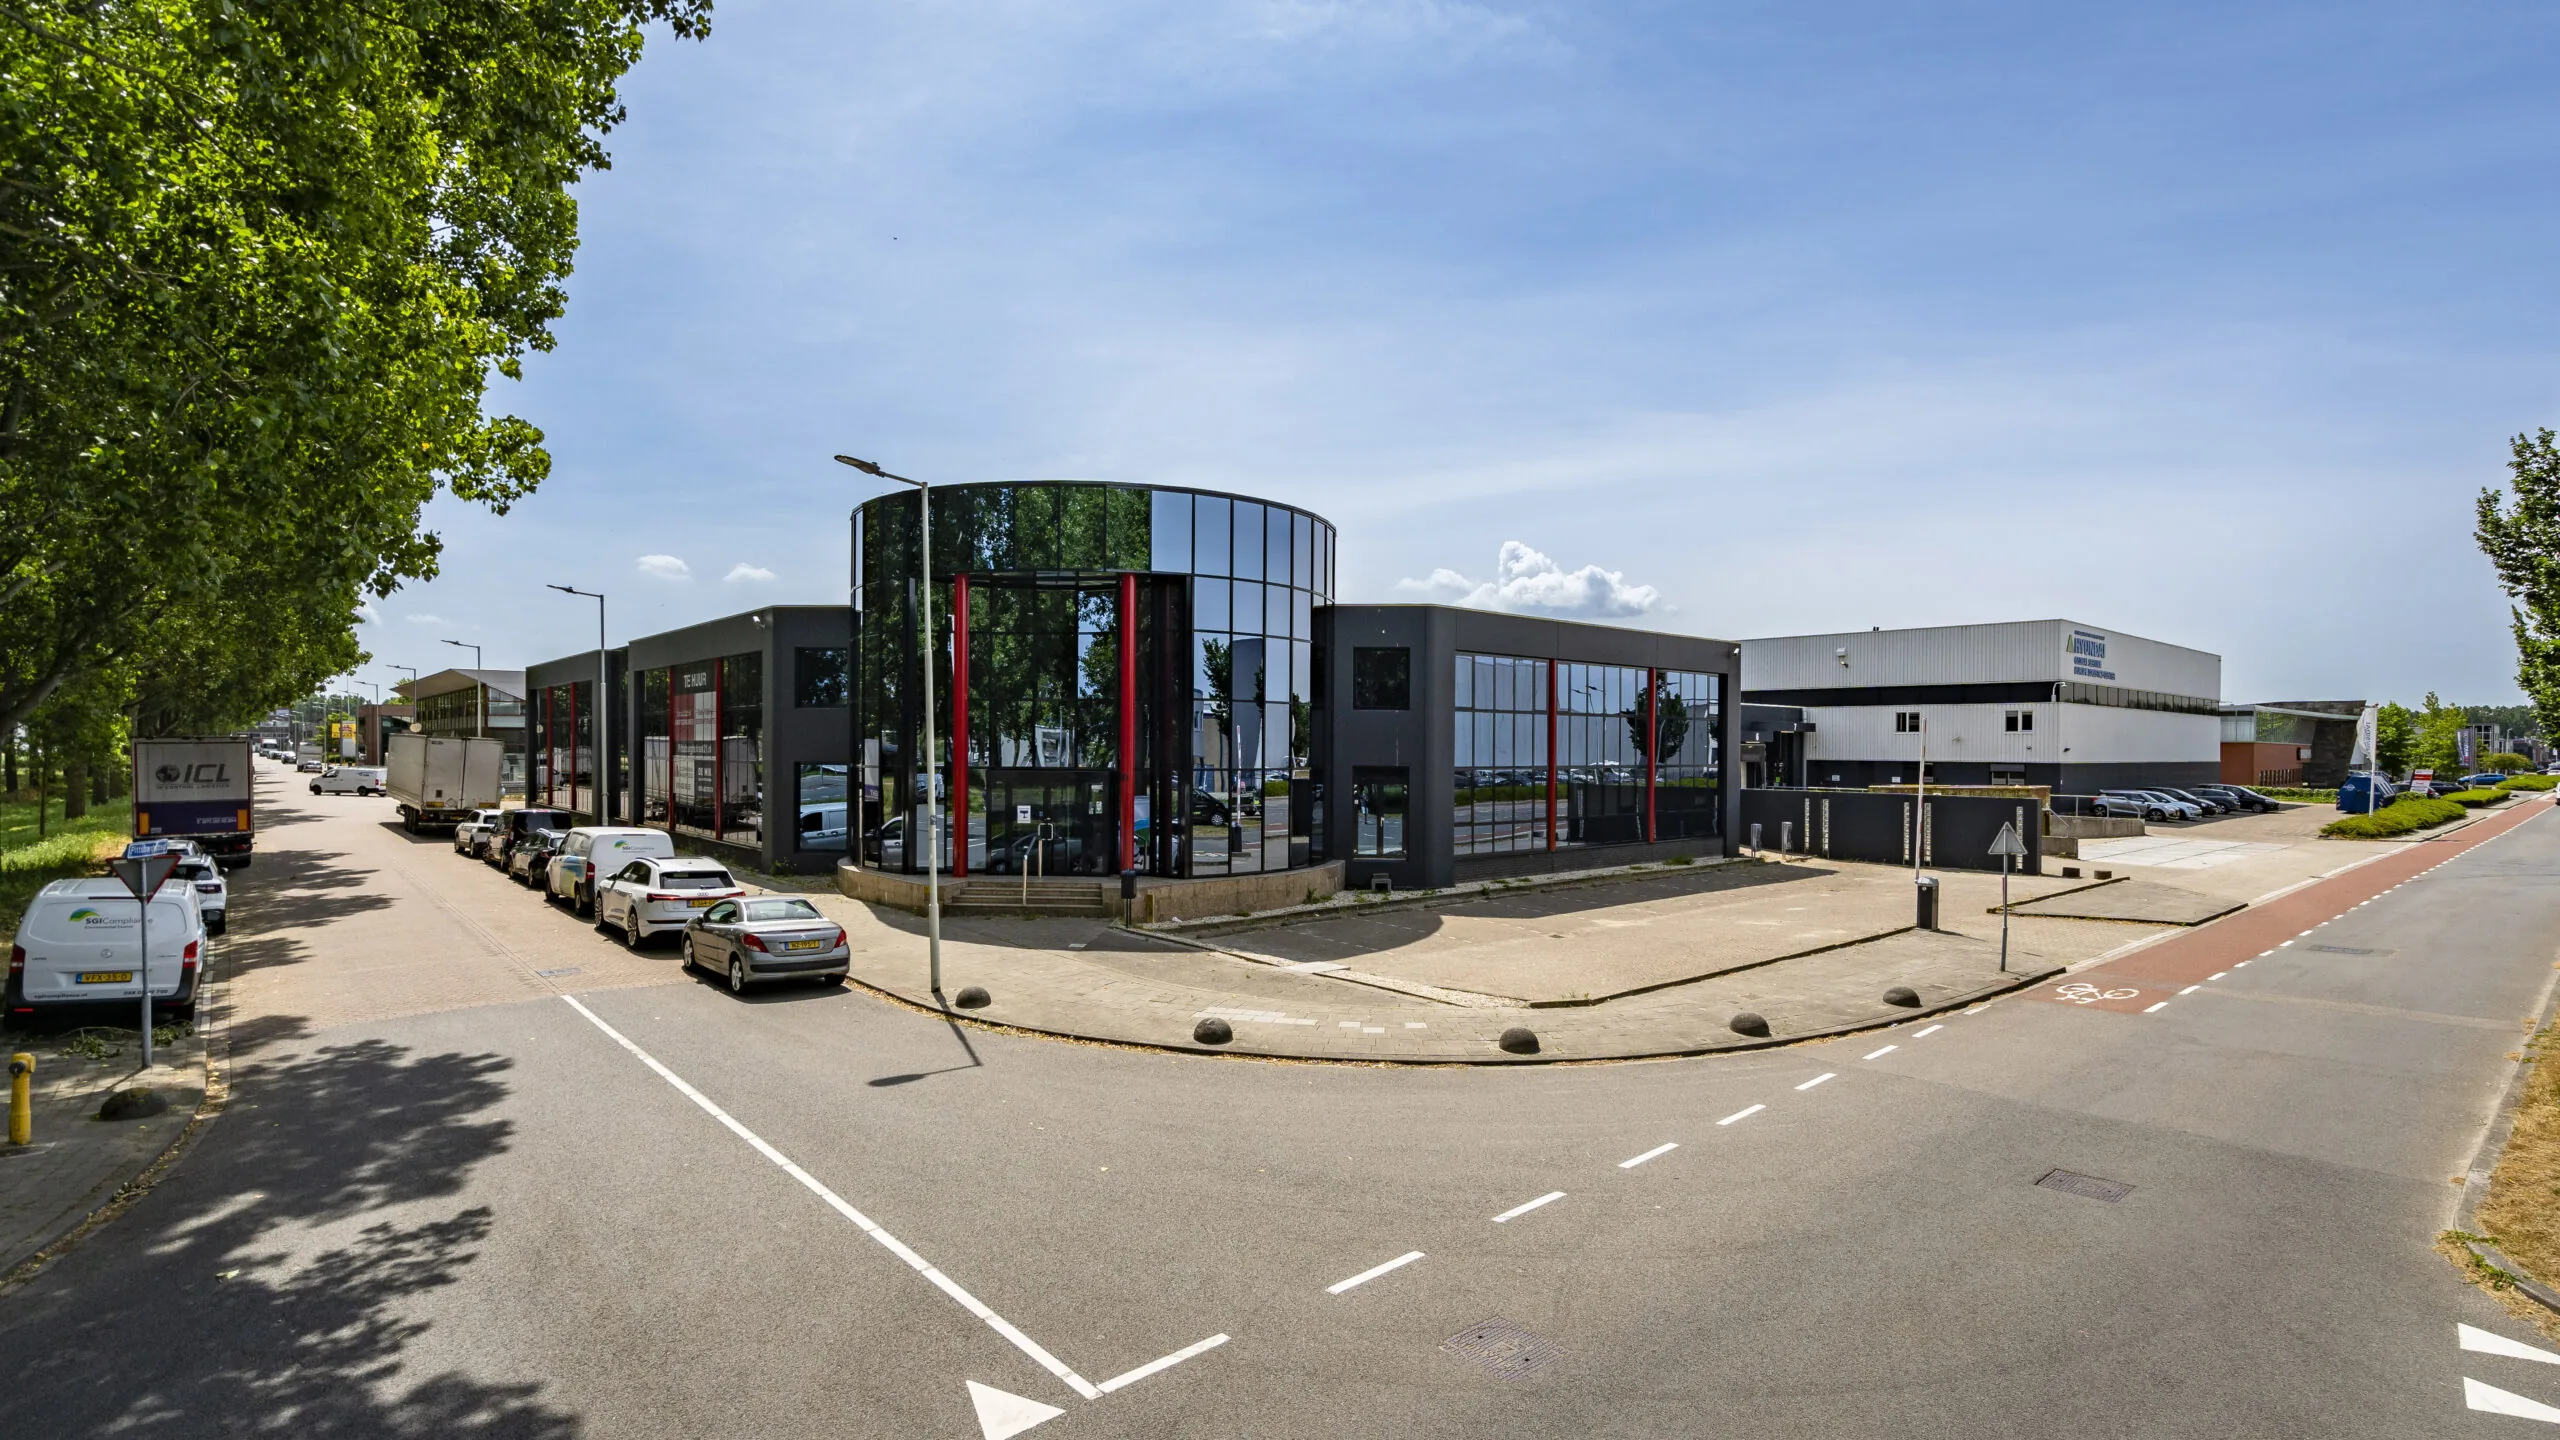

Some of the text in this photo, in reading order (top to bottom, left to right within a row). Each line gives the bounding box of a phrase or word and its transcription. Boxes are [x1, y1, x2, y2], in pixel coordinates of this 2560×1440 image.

[2074, 638, 2105, 658] HYUNDAI
[683, 672, 707, 688] TE HUUR
[184, 764, 231, 783] ICL
[86, 917, 153, 926] SGICompliane
[84, 973, 128, 982] VFX-35-D
